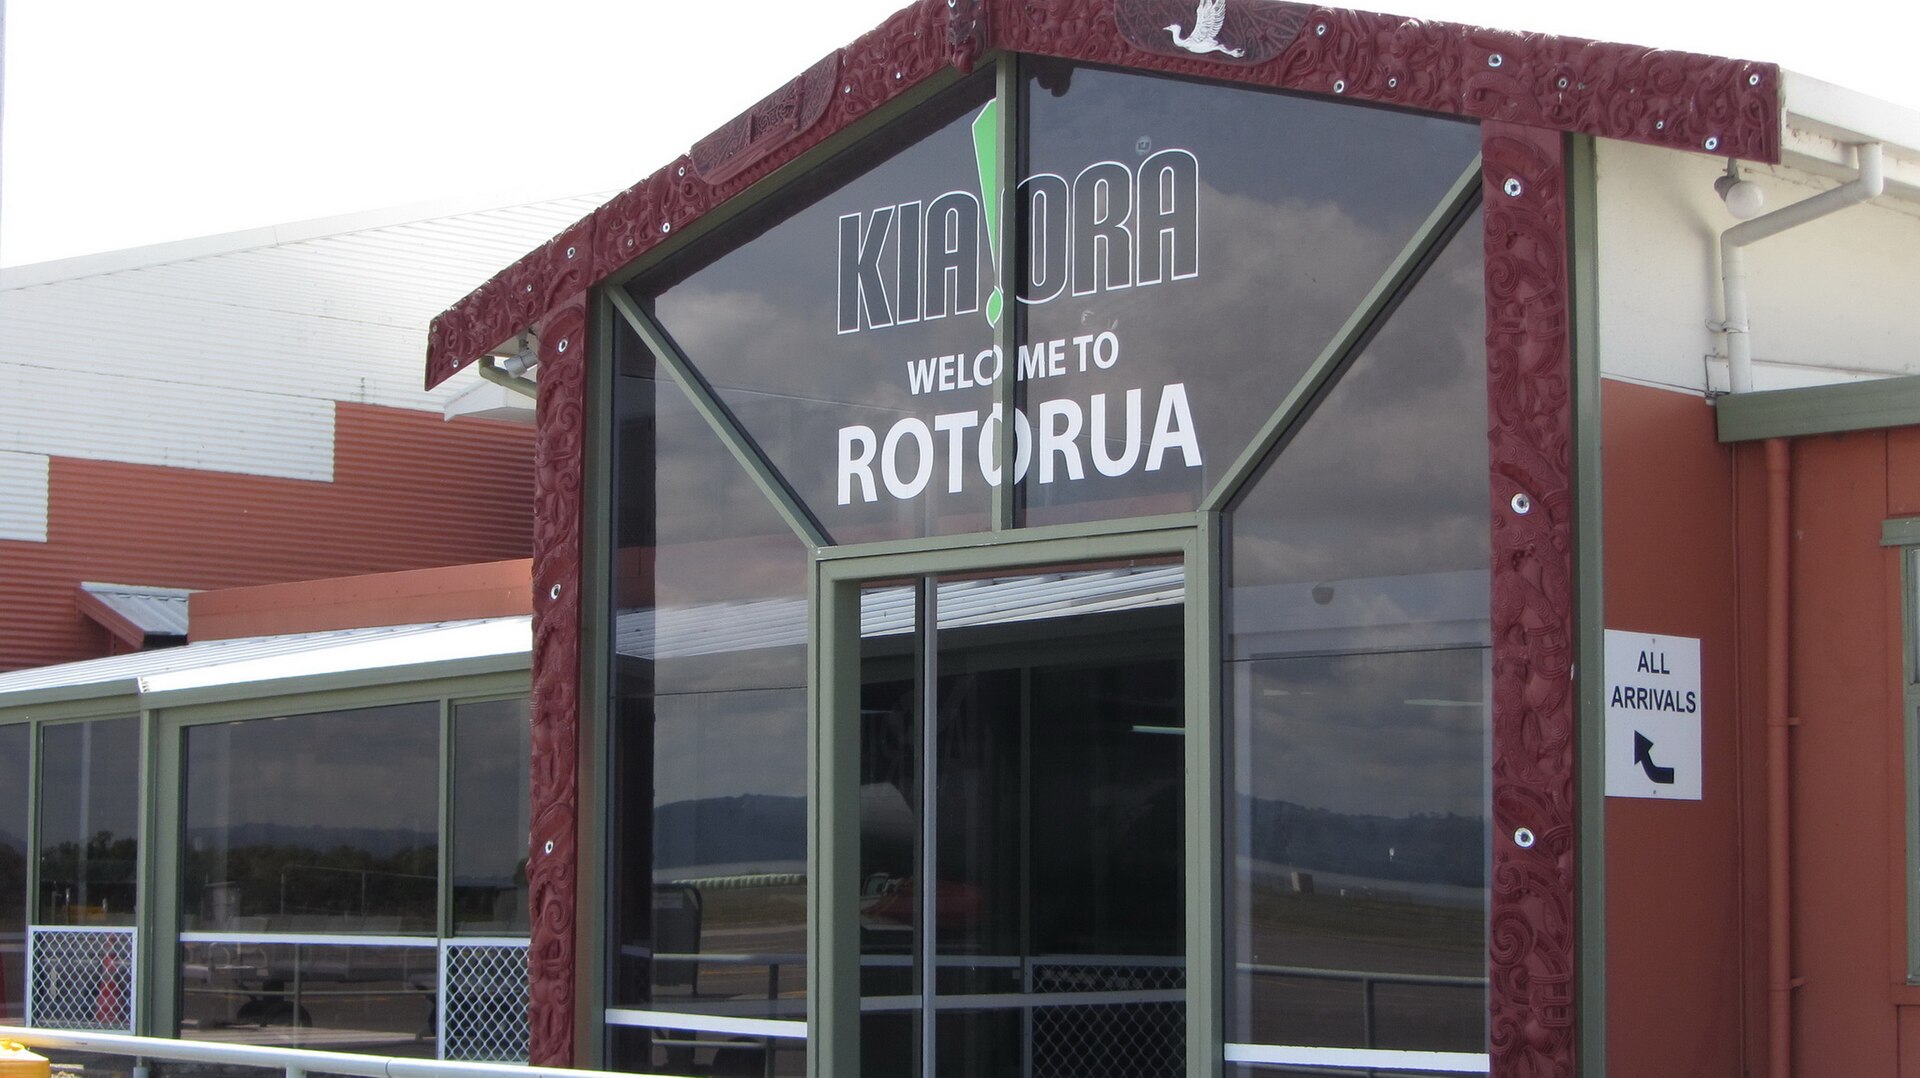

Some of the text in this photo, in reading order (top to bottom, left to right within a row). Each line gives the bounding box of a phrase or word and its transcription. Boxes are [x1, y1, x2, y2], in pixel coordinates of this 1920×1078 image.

[1073, 331, 1119, 372] TO
[838, 382, 1202, 506] ROTORUA
[1637, 650, 1670, 675] ALL
[1611, 685, 1696, 714] ARRIVALS
